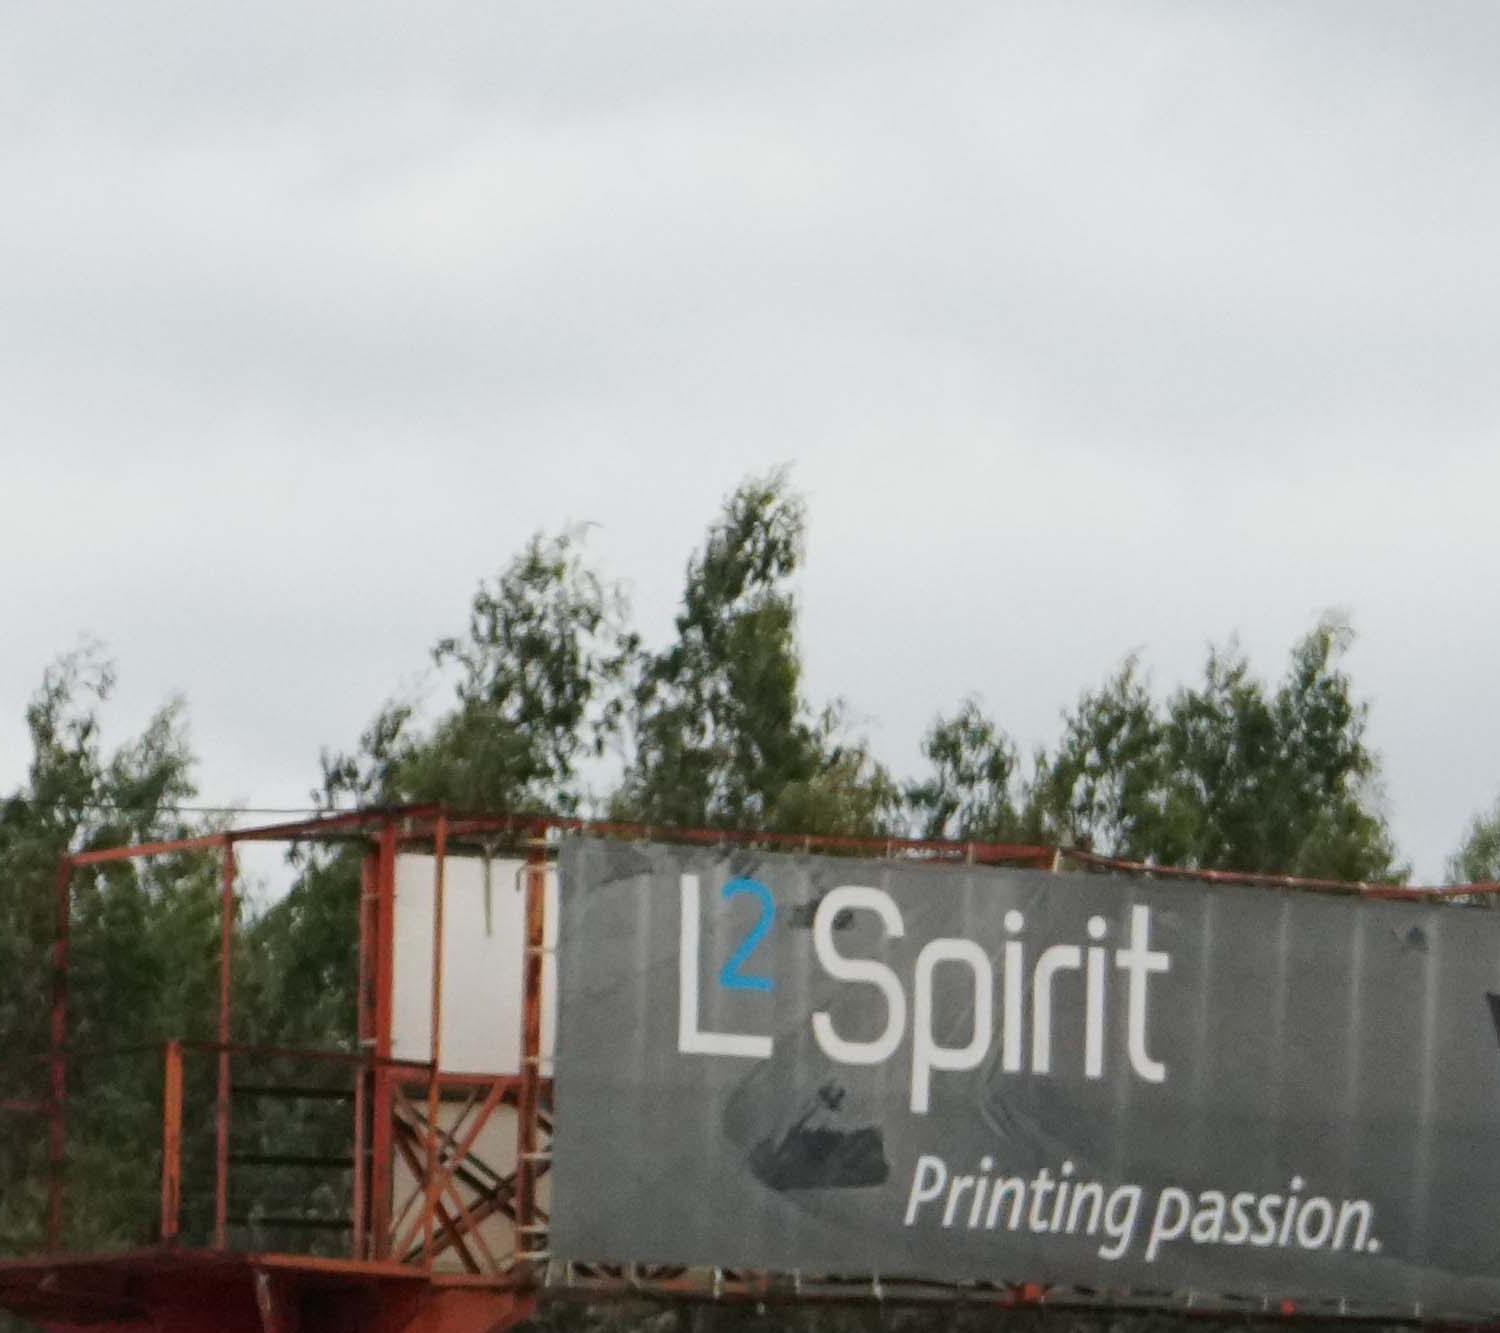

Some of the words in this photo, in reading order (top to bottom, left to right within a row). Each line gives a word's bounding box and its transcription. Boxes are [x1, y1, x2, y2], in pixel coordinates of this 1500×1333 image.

[812, 885, 1171, 1114] Spirit
[904, 1154, 1140, 1260] Printing
[1145, 1178, 1383, 1263] passion.
